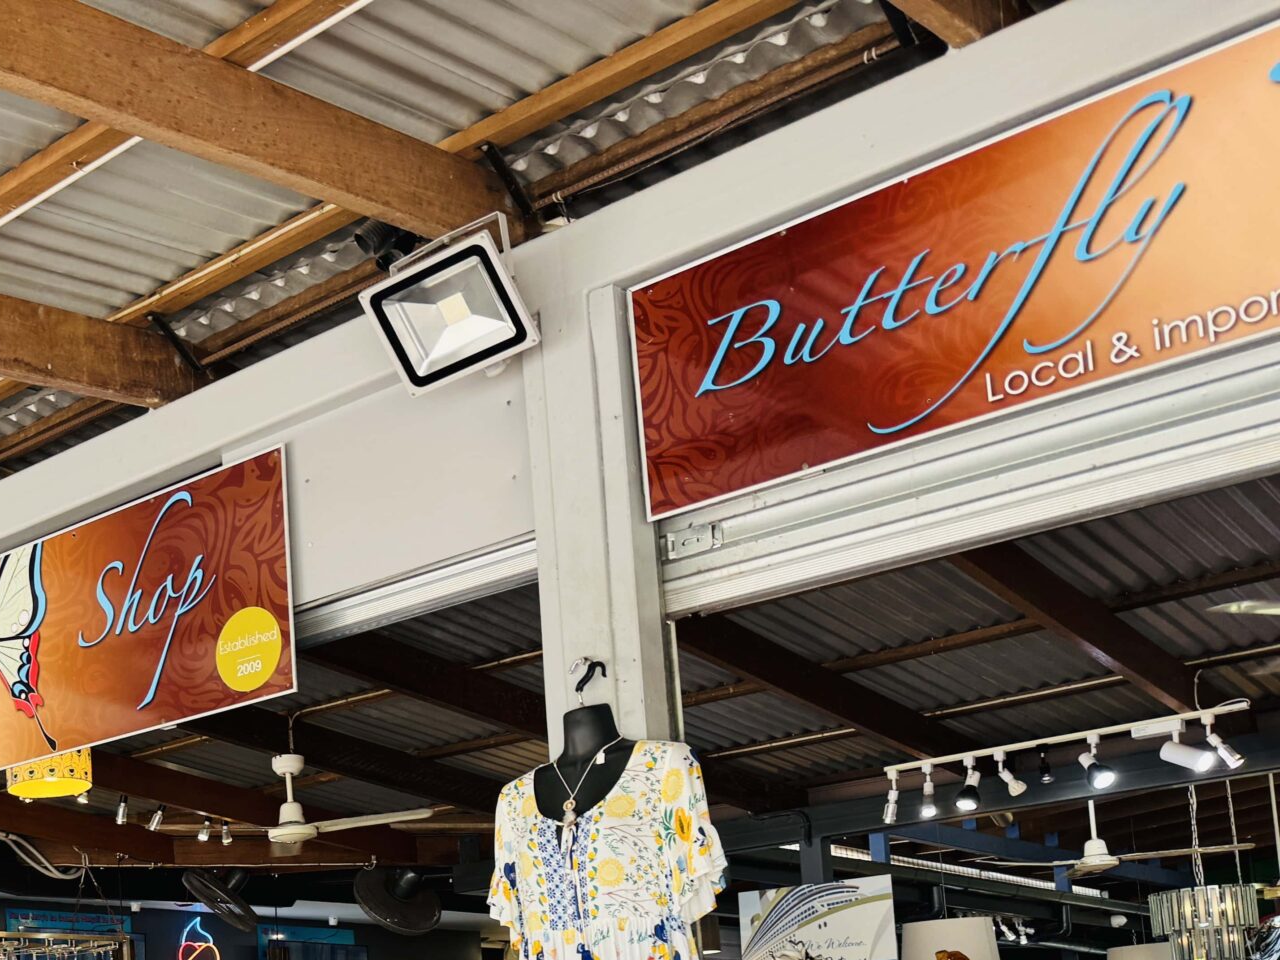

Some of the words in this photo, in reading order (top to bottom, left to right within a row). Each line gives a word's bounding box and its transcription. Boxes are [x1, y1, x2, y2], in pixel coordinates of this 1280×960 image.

[695, 90, 1191, 434] Butterfly
[984, 340, 1095, 403] Local
[1110, 331, 1139, 363] &
[77, 490, 216, 710] Shop
[219, 626, 278, 655] Established
[236, 658, 262, 677] 2009
